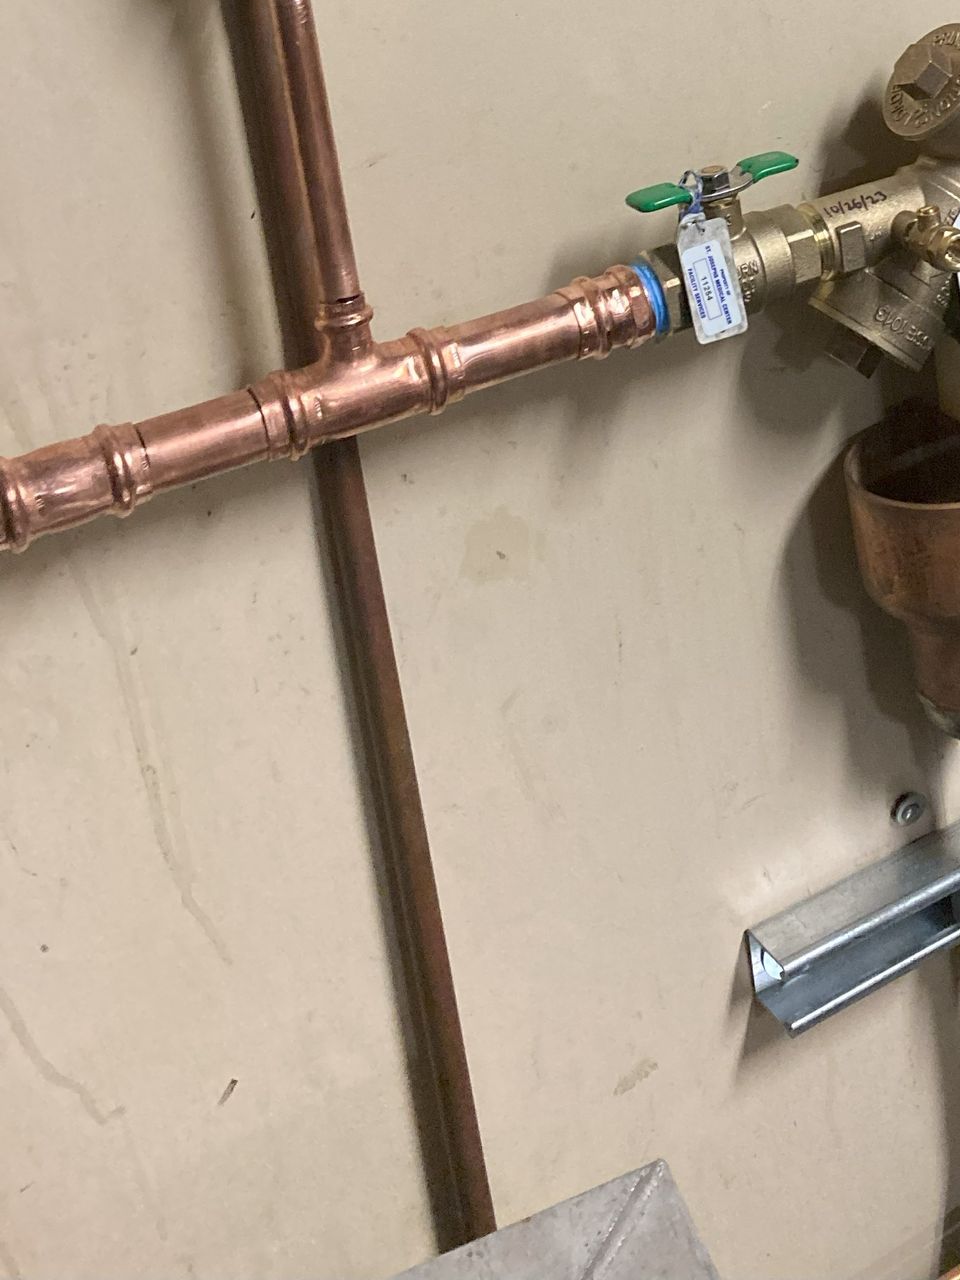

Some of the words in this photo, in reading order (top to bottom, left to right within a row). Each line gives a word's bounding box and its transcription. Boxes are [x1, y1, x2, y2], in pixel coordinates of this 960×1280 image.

[824, 191, 888, 218] 10/26/23
[688, 268, 698, 292] FACILITY
[694, 294, 706, 319] SERVICES
[701, 276, 713, 301] 11254
[715, 280, 726, 303] MEDICAL
[722, 303, 732, 325] CENTER
